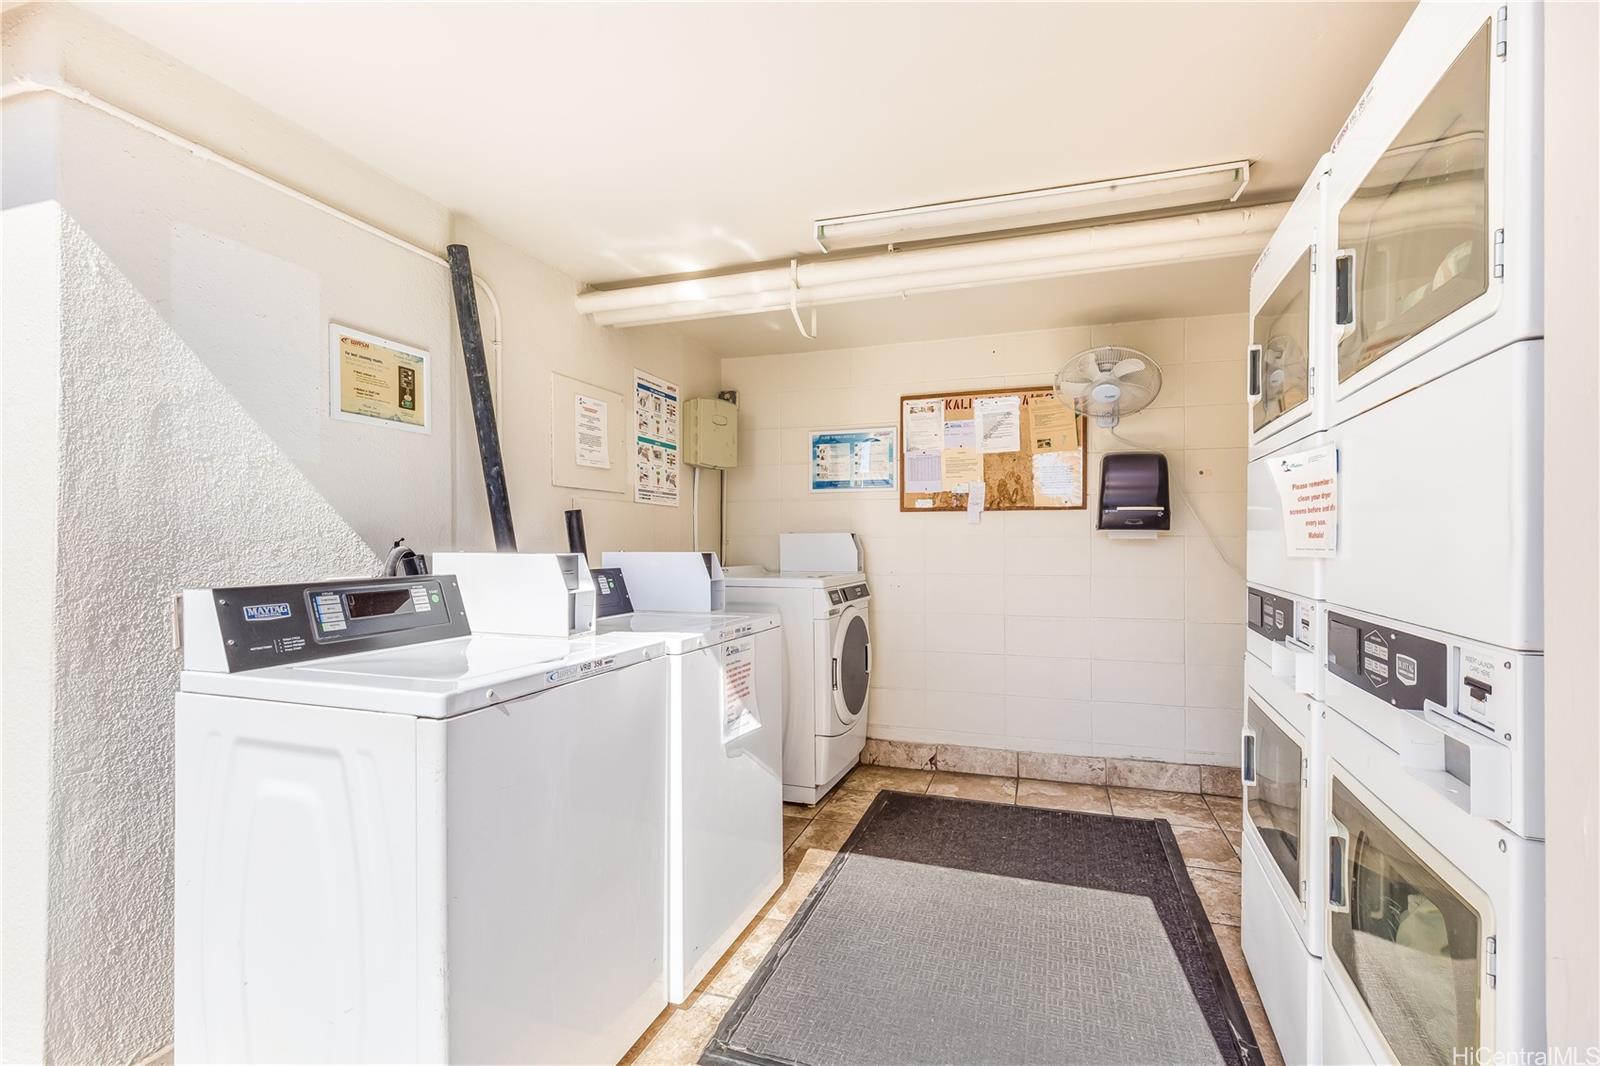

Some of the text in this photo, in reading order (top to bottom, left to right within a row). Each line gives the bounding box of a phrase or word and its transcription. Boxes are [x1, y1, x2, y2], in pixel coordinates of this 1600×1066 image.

[1292, 483, 1308, 491] Please
[1309, 479, 1330, 488] remember
[1311, 494, 1321, 503] your
[1321, 492, 1332, 501] dryer
[1307, 506, 1321, 514] before
[1305, 520, 1317, 528] every
[247, 604, 288, 617] MAYTAG
